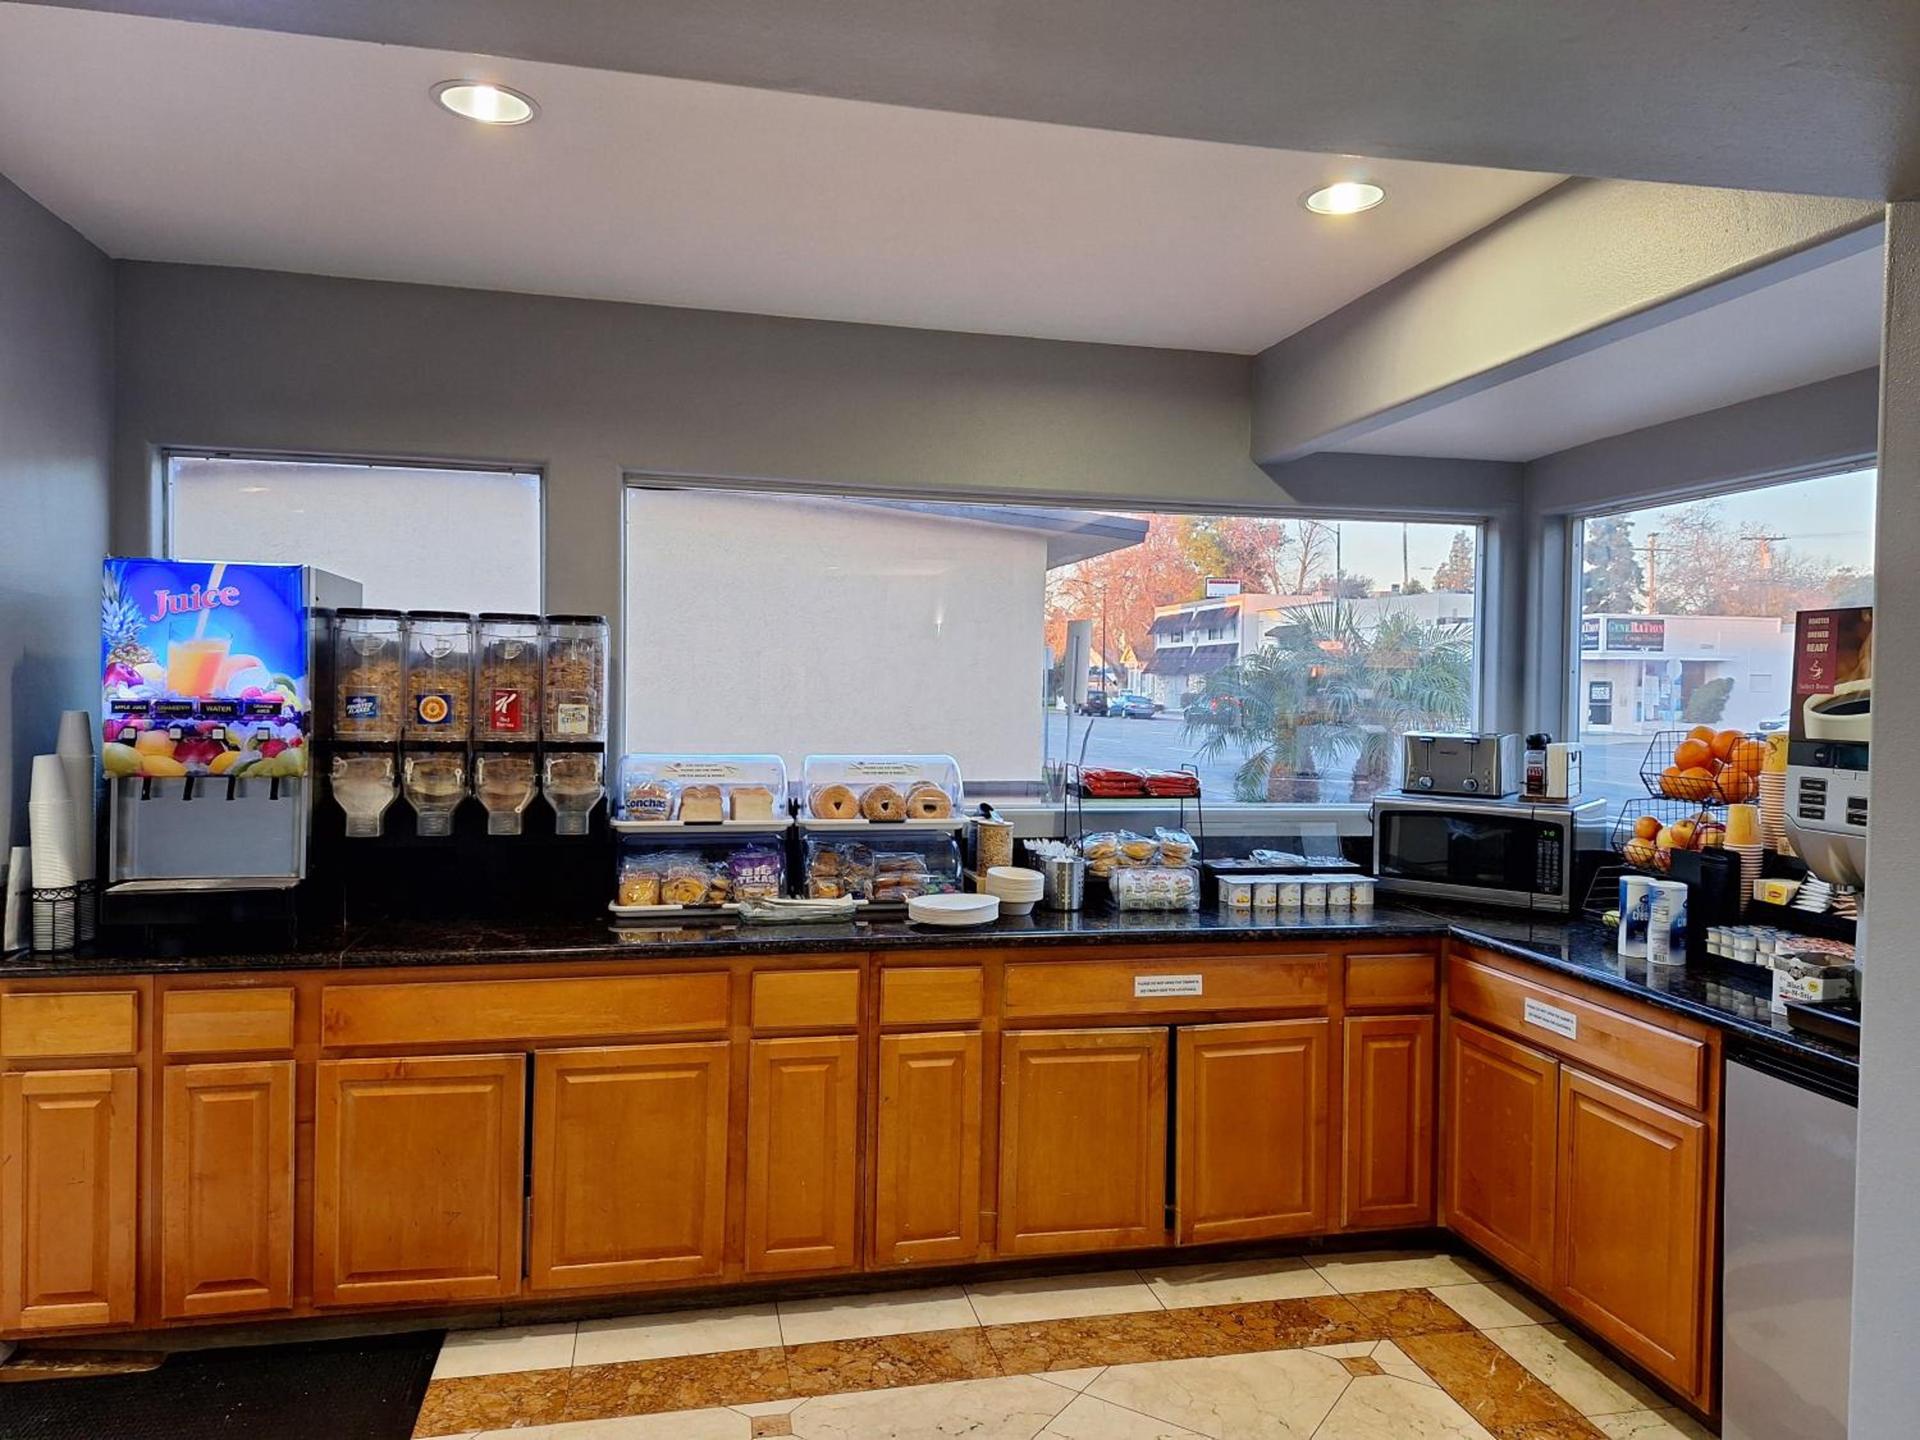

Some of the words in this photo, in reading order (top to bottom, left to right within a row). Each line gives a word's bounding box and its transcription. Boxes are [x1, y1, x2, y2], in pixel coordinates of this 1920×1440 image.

[149, 584, 240, 622] Juice
[1806, 643, 1828, 652] READY
[205, 704, 232, 712] WATER
[741, 866, 772, 876] BIG
[737, 874, 776, 884] TEXAS
